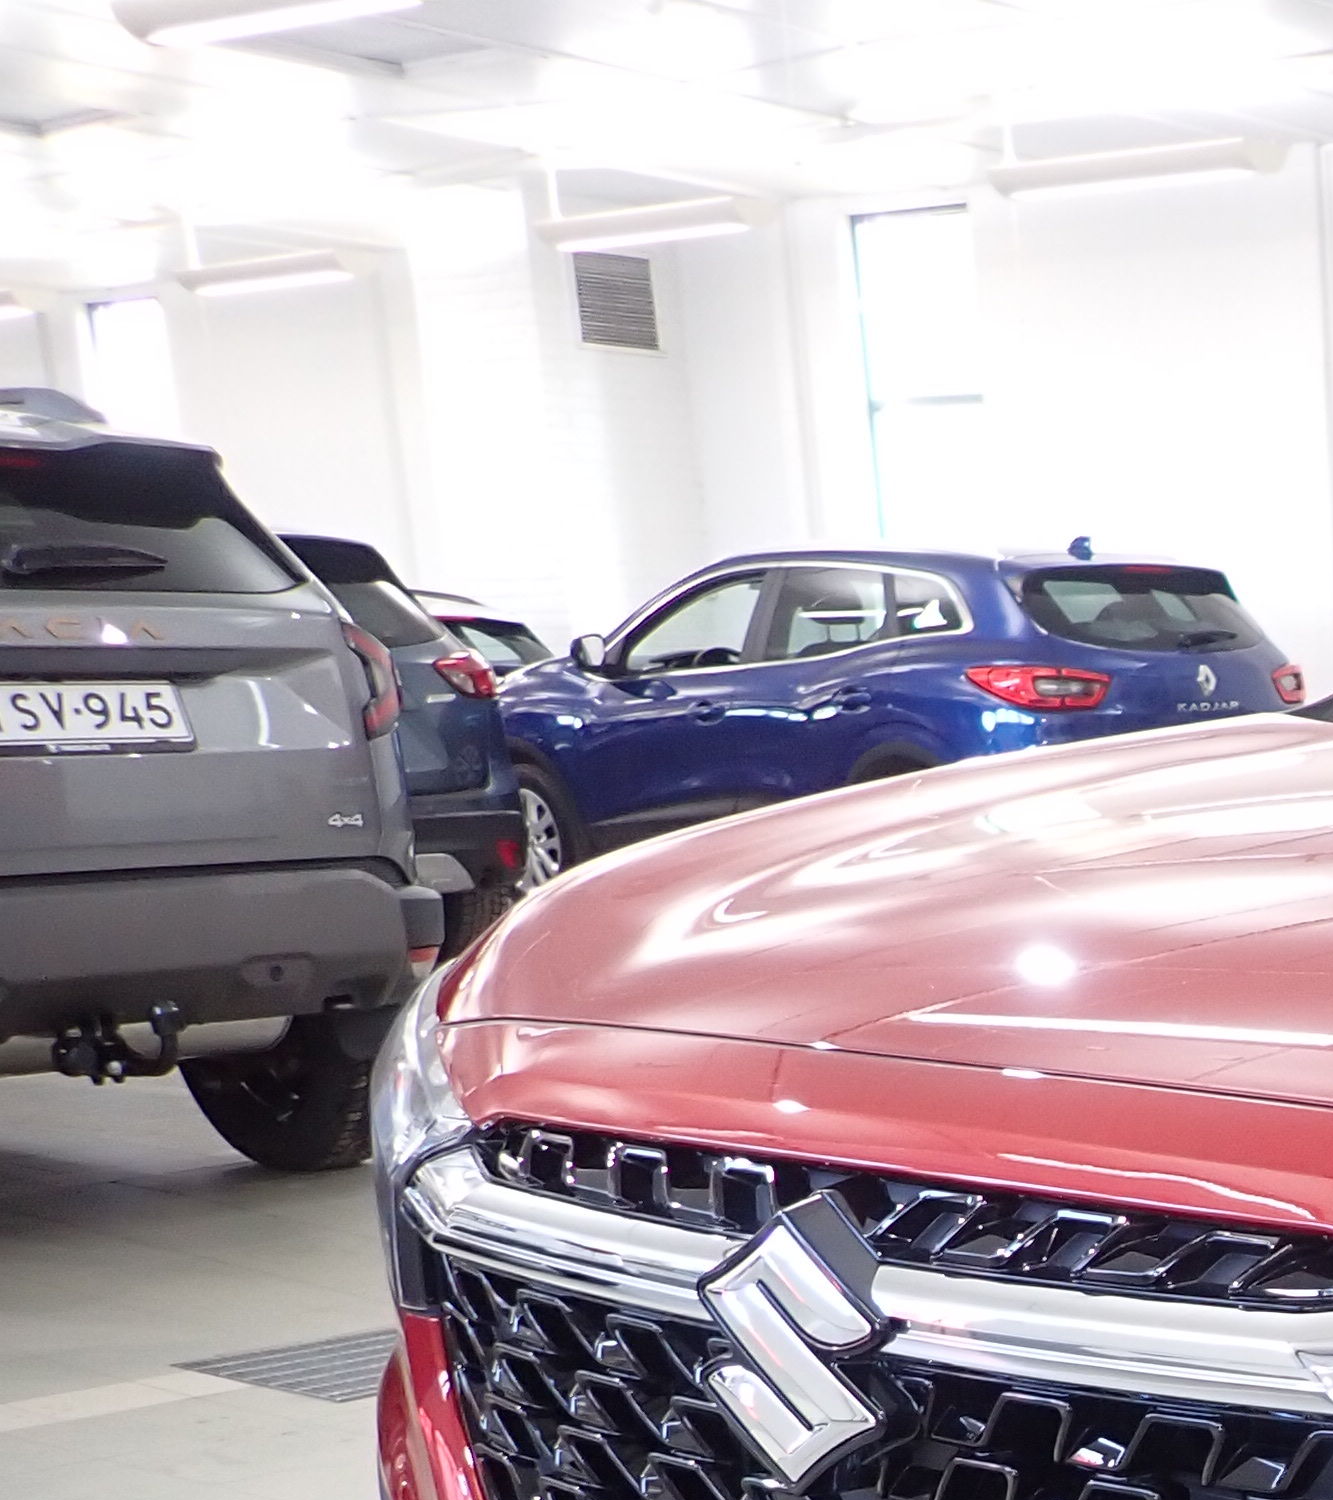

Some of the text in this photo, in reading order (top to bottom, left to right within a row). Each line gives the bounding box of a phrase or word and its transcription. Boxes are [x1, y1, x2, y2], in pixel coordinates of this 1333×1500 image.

[0, 691, 174, 732] SV-945
[1176, 700, 1239, 713] KADJAR
[327, 812, 364, 828] 4x4
